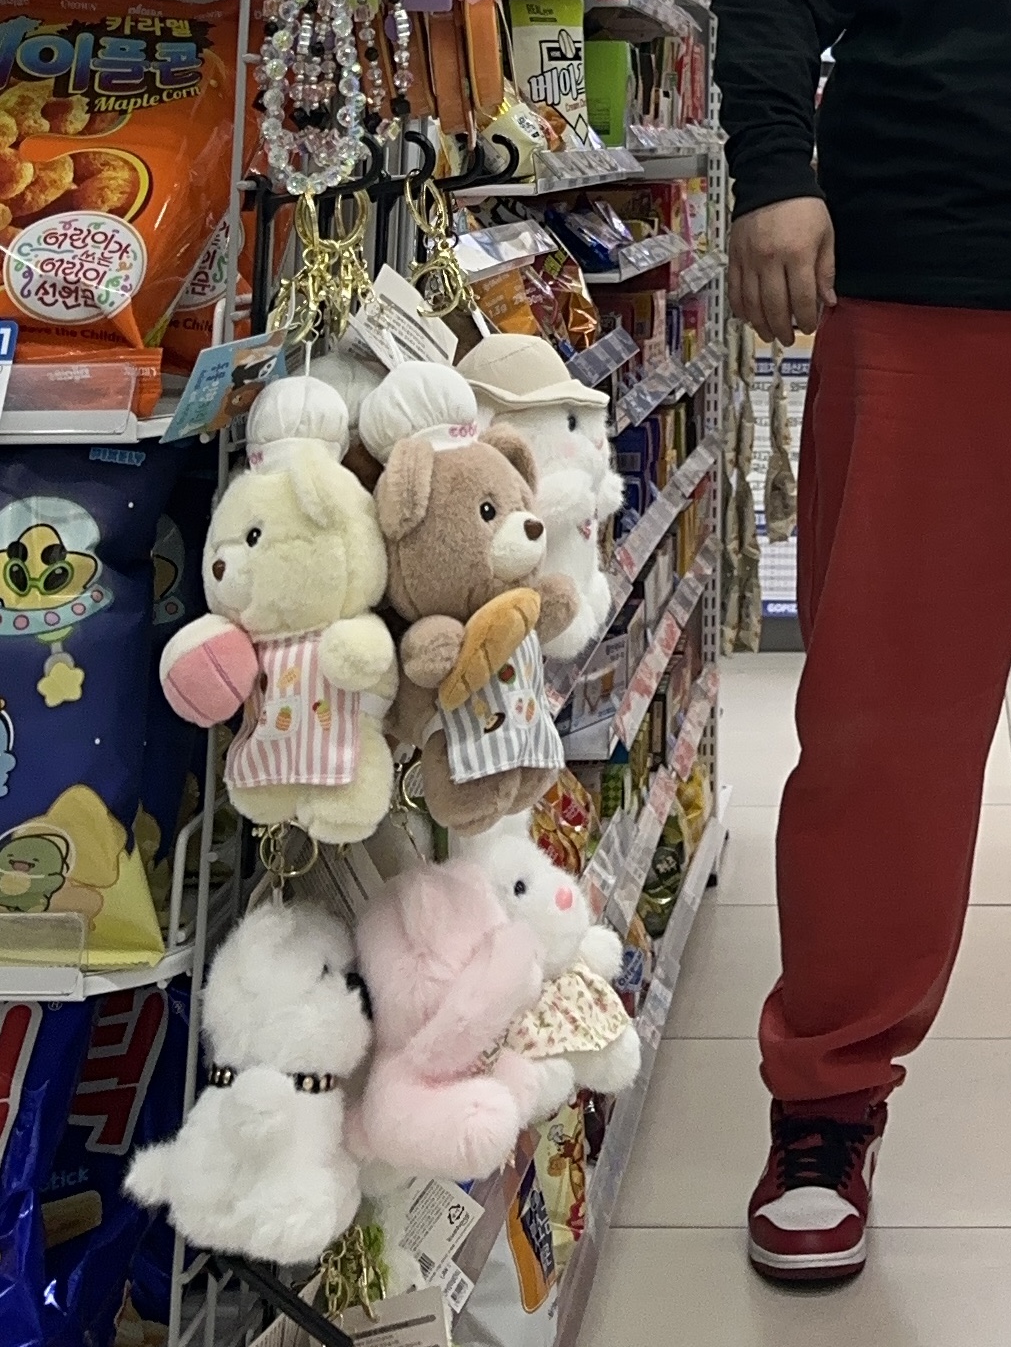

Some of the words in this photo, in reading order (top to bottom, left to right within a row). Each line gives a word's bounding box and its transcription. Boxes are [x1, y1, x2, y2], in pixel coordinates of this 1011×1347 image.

[106, 16, 192, 38] 카라멜
[94, 94, 160, 115] Maple
[162, 85, 201, 103] Corn
[43, 226, 132, 260] 어린이가
[40, 256, 108, 288] 어린이
